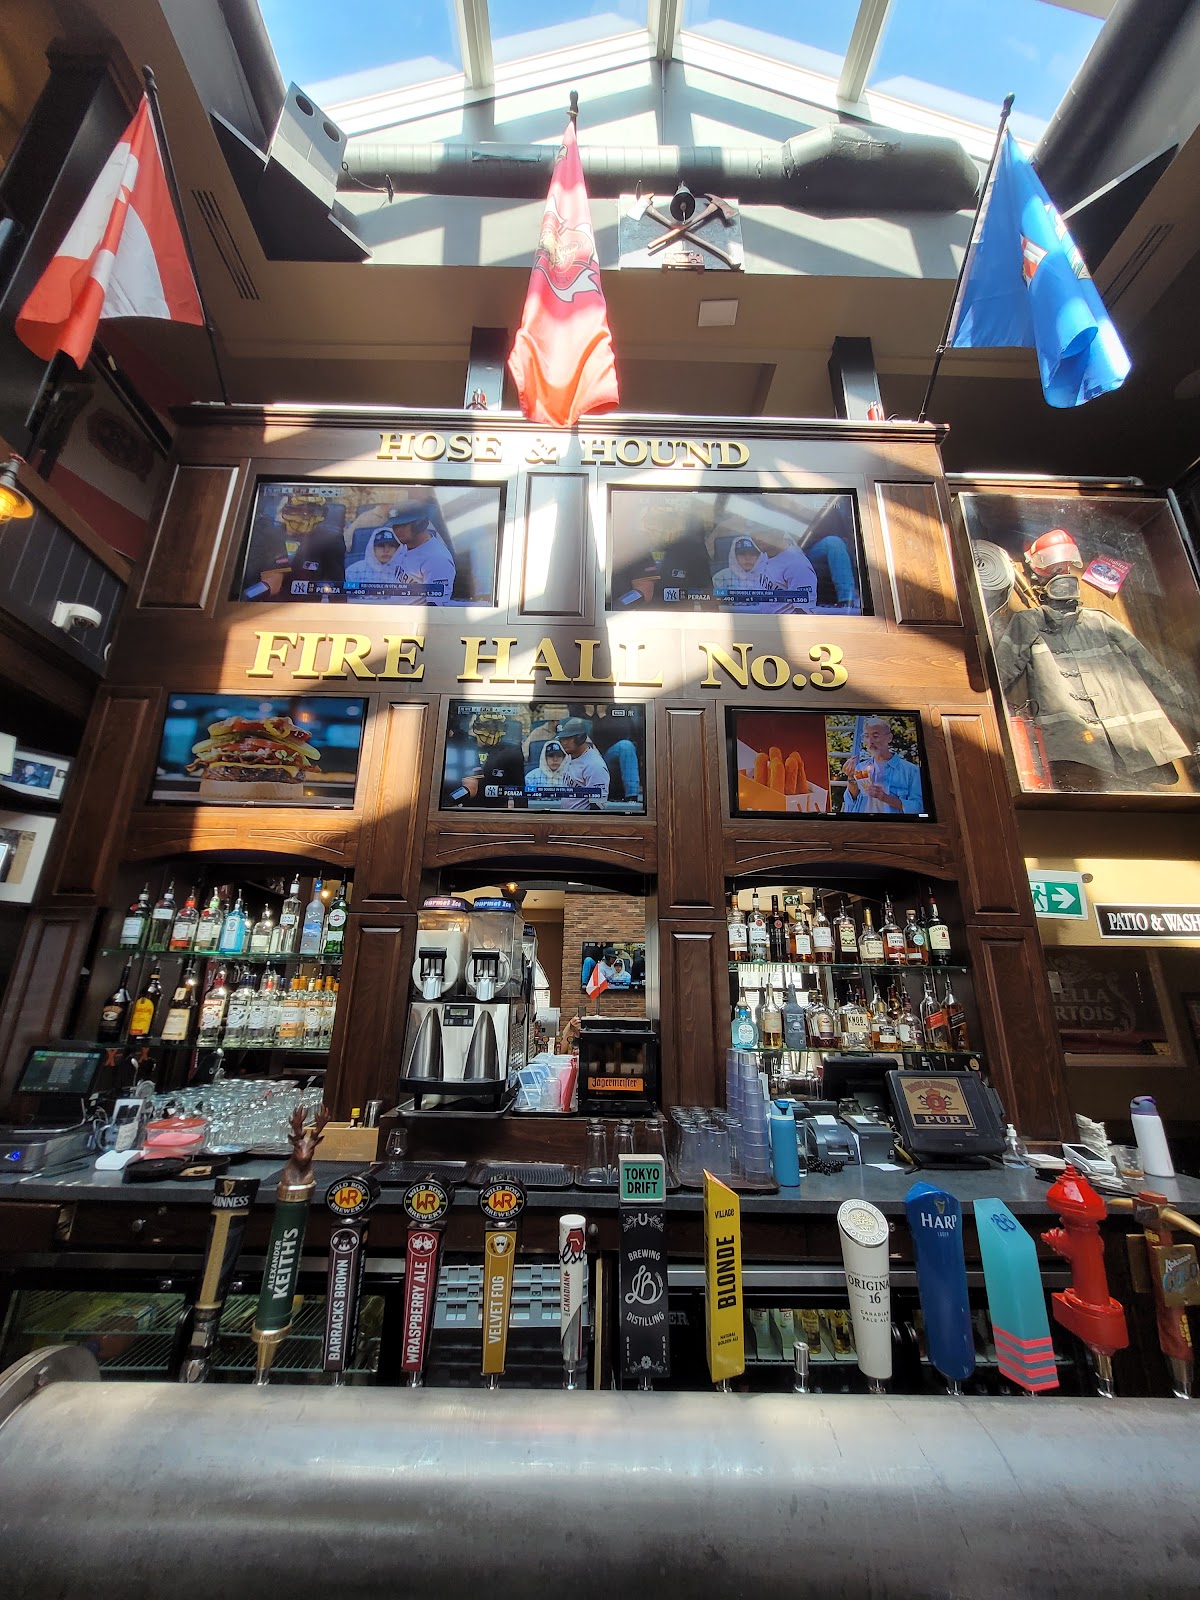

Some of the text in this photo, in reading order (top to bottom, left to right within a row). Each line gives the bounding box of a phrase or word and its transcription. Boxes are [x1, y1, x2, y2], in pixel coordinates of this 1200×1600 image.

[377, 432, 502, 462] HOSE
[581, 438, 750, 468] HOUND
[245, 631, 849, 691] FIRE HALL No.3
[1106, 912, 1149, 931] PATIO
[1150, 913, 1165, 931] &
[1053, 987, 1110, 1003] ELLA
[923, 1115, 962, 1124] PUB
[625, 1168, 660, 1180] TOKYO
[331, 1182, 366, 1195] WILD ROSE
[408, 1185, 444, 1199] WILD ROSE
[485, 1185, 521, 1199] WILD ROSE
[627, 1182, 658, 1194] DRIFT
[212, 1195, 251, 1208] UINNESS
[331, 1202, 365, 1214] BREWERY
[408, 1206, 442, 1220] BREWERY
[485, 1206, 519, 1218] BREWERY
[920, 1212, 957, 1230] HARP
[627, 1248, 661, 1261] BREWING
[267, 1240, 282, 1290] ALEXANDER
[272, 1227, 298, 1300] KEITH'S
[716, 1234, 737, 1310] BLONDE
[563, 1274, 571, 1312] CANADIAN
[869, 1291, 881, 1304] 16
[328, 1259, 349, 1361] BARRACKS BROWN
[406, 1261, 428, 1363] WRASPBERRY ALE
[488, 1275, 505, 1344] VELVET FOG
[626, 1311, 665, 1327] DISTILLING
